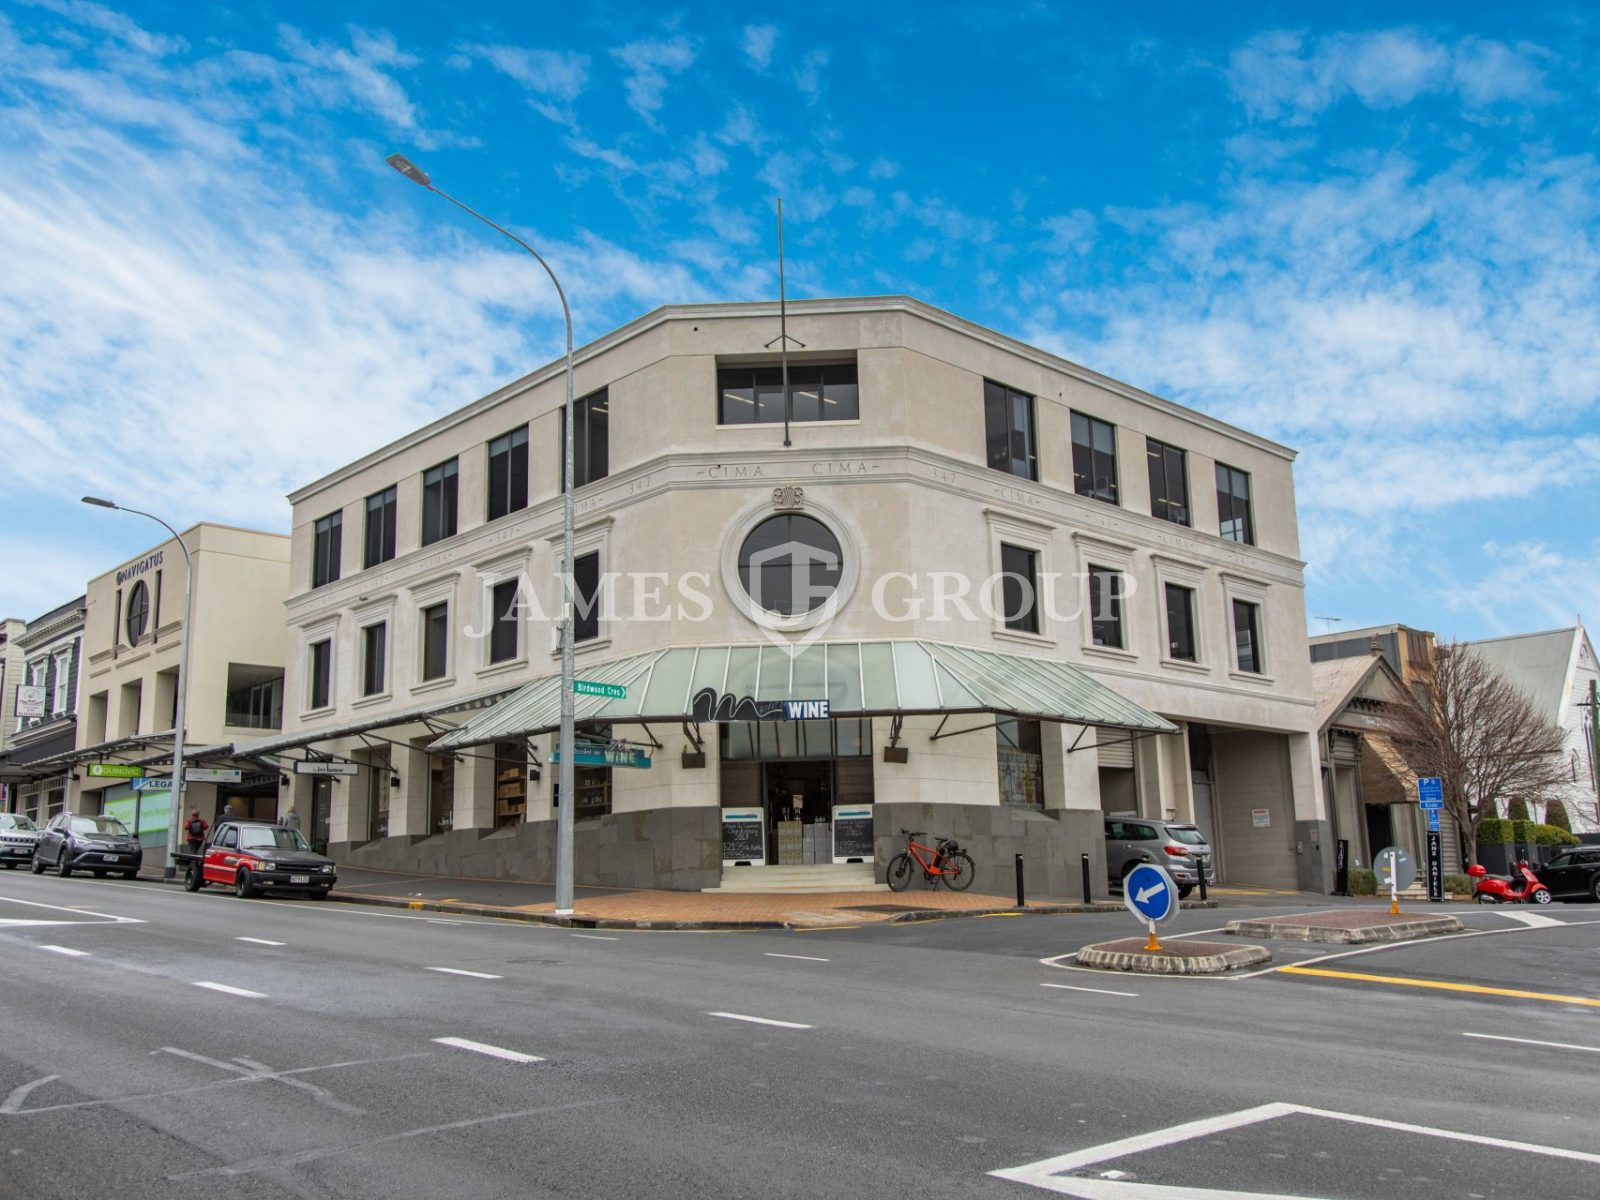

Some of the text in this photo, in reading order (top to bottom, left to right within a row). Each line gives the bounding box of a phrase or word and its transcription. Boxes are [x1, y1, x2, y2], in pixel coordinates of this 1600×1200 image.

[120, 551, 163, 583] NAVIGATUS
[578, 683, 621, 696] Birdwood Cres
[788, 701, 829, 718] WINE
[604, 750, 636, 764] WINE
[102, 767, 139, 776] QUINOVIC
